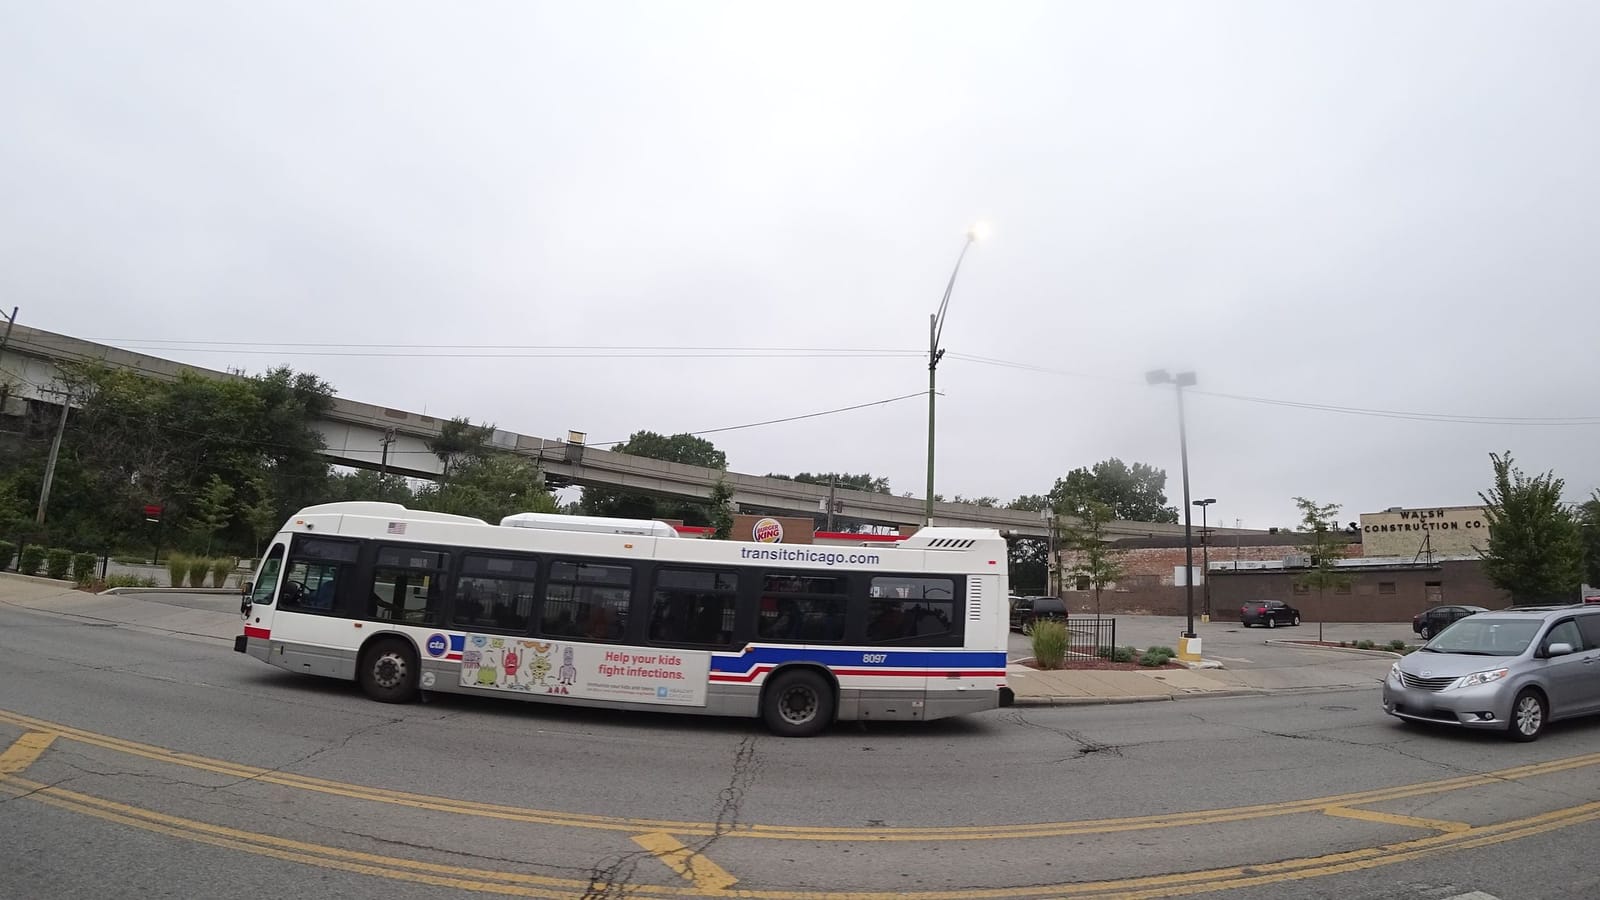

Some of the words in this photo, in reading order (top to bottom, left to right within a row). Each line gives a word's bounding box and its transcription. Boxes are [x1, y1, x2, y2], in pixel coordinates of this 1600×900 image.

[1400, 509, 1444, 519] WALSH
[757, 524, 779, 533] BURGER
[1364, 521, 1458, 533] CONSTRUCTION
[1465, 520, 1486, 529] CO.
[757, 530, 780, 540] KING
[741, 547, 880, 565] transitchicago.com
[429, 640, 445, 649] cta
[605, 651, 630, 664] Help
[632, 655, 657, 665] your
[658, 655, 682, 666] kids
[862, 653, 887, 663] 8097
[598, 664, 625, 677] fight
[626, 666, 685, 680] infections.
